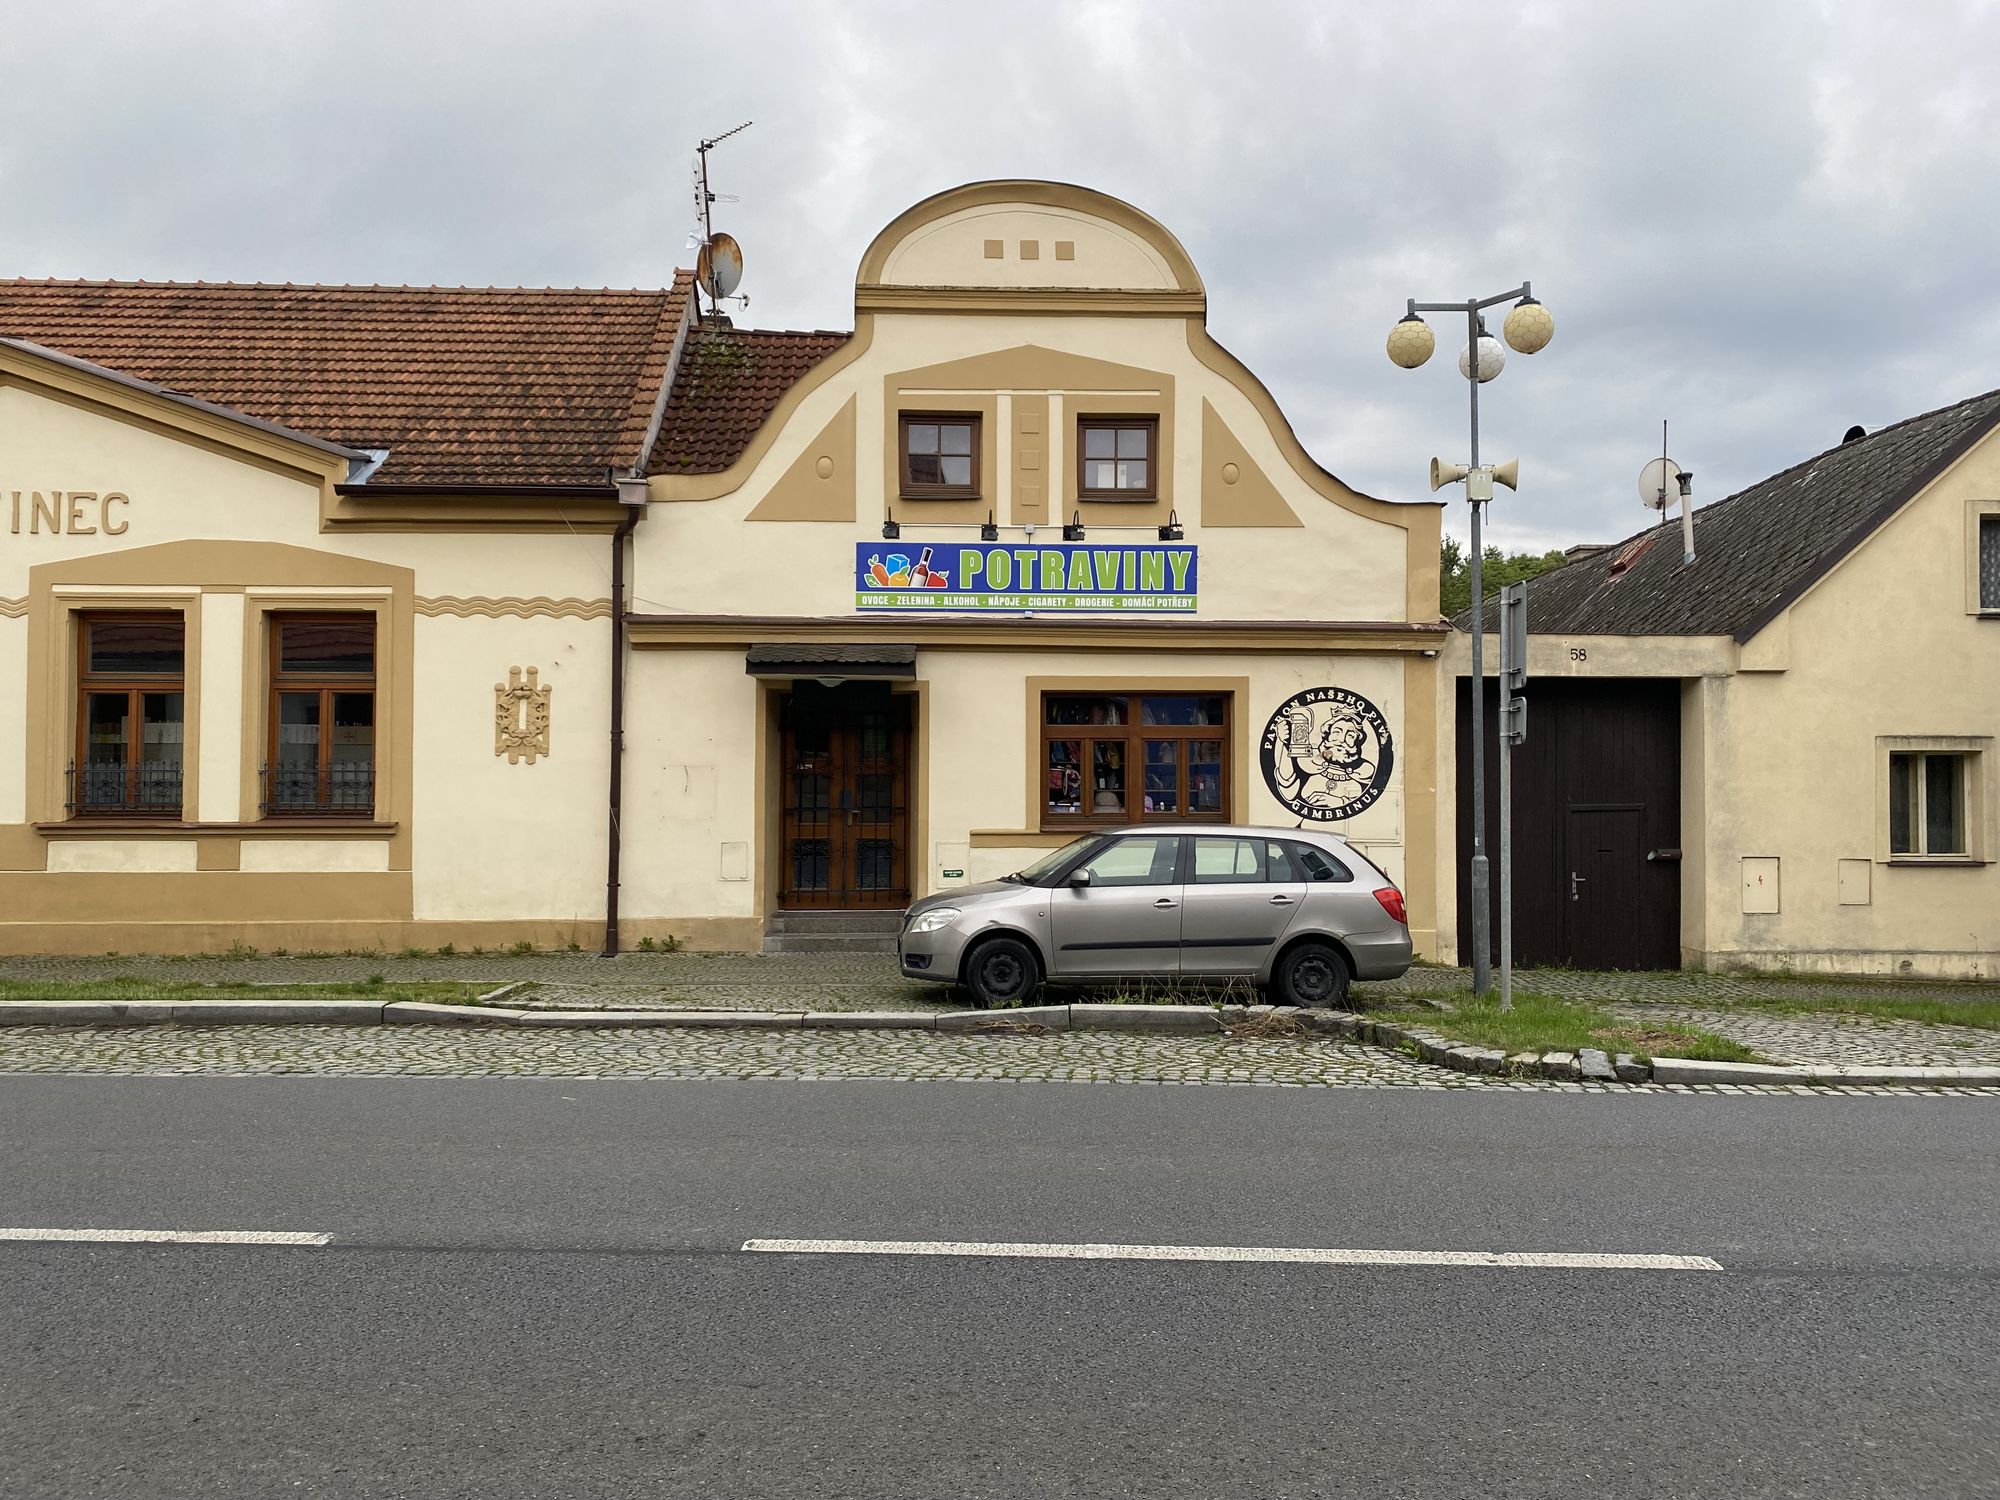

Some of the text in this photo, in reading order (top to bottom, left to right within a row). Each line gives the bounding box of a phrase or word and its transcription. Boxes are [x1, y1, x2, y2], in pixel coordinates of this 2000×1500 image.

[0, 491, 130, 535] INEC
[959, 549, 1193, 591] POTRAVINY
[861, 595, 889, 605] OVOCE
[896, 595, 935, 606] ZELENINA
[943, 596, 980, 606] ALKOHOL
[988, 595, 1020, 607] NÁPOJE
[1028, 597, 1067, 607] CIGARETY
[1075, 597, 1114, 607] DROGERIE
[1122, 595, 1155, 608] DOMÁCÍ
[1156, 596, 1193, 608] POTŘEBY
[1570, 648, 1587, 661] 58
[1264, 689, 1389, 750] PATRON NAŠEHO PIV
[1291, 787, 1378, 819] GAMBRINUS
